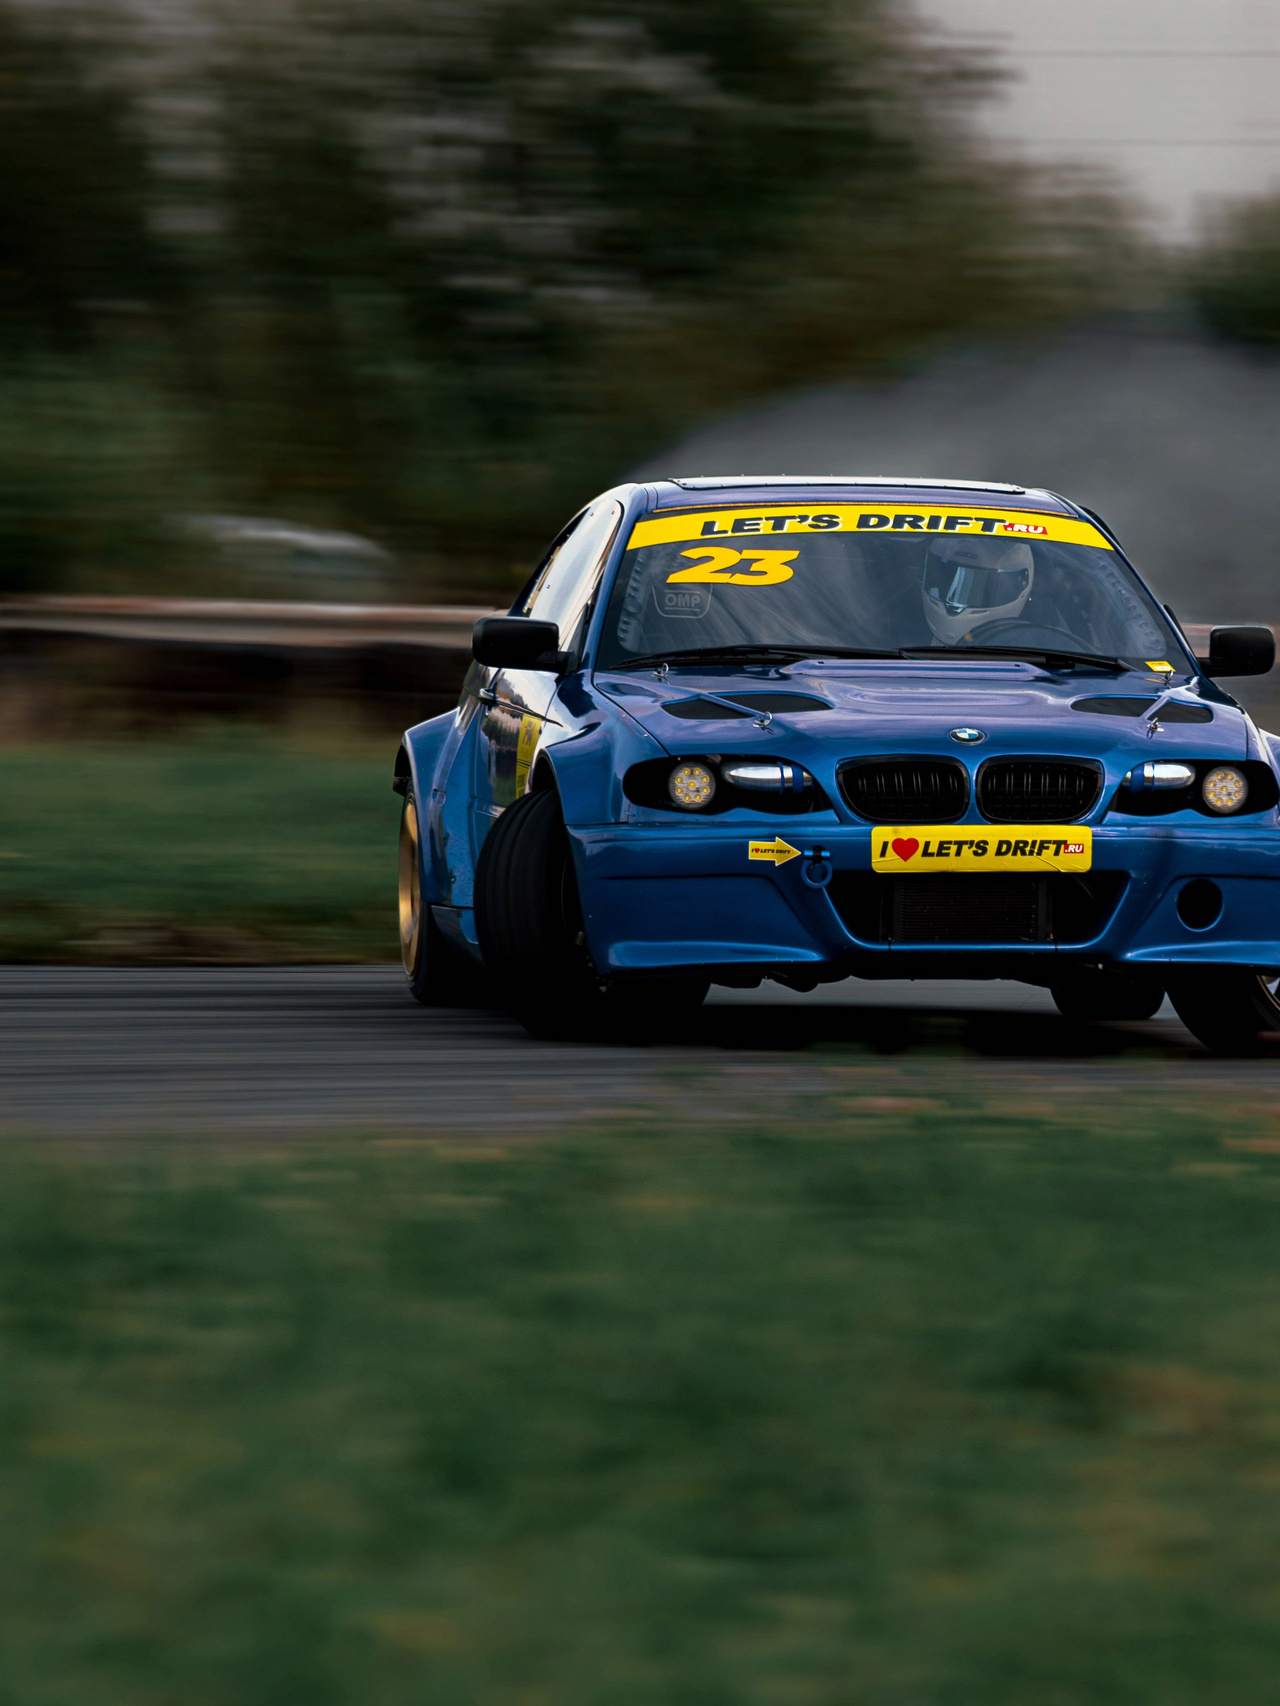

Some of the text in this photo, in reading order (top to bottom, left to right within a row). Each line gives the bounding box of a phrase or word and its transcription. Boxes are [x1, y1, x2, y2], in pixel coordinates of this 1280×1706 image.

[701, 514, 840, 536] LET'S
[666, 546, 800, 586] 23
[665, 593, 700, 607] OMP
[880, 841, 889, 857] I
[921, 838, 988, 857] LET'S
